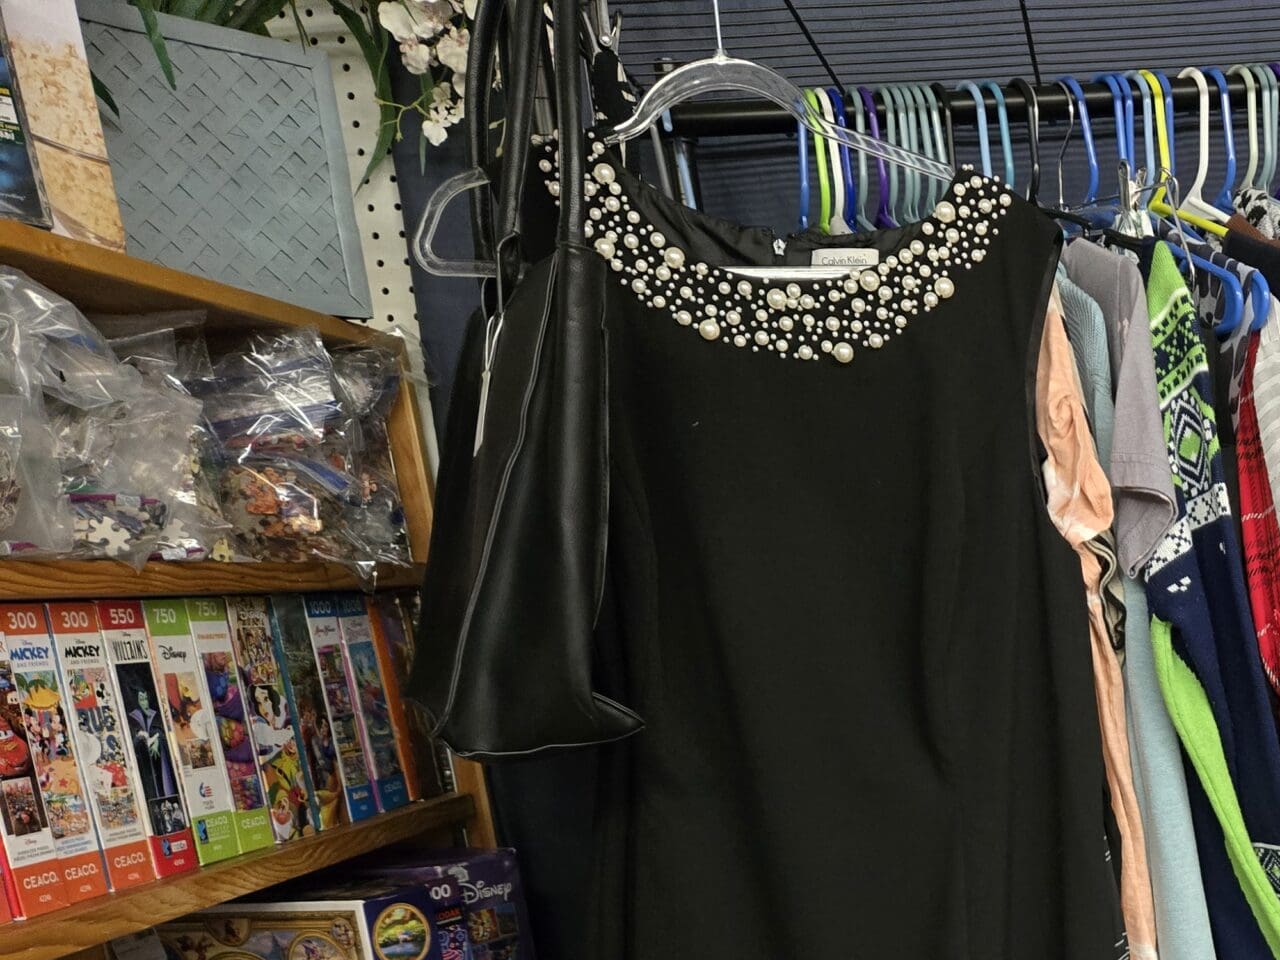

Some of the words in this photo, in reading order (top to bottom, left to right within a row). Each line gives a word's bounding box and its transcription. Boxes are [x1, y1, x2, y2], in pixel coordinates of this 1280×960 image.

[821, 256, 846, 265] Calvin
[846, 256, 868, 265] Klein
[195, 601, 218, 617] 750
[309, 600, 332, 614] 1000
[7, 611, 37, 629] 300
[61, 611, 89, 628] 300
[109, 608, 135, 625] 550
[153, 608, 177, 624] 750
[10, 646, 49, 661] MICKEY
[65, 645, 100, 658] MICKEY
[112, 639, 148, 662] VILLAINS
[159, 644, 187, 662] Disney
[424, 883, 451, 900] 00
[459, 880, 512, 904] Disney
[438, 907, 461, 920] ODAK
